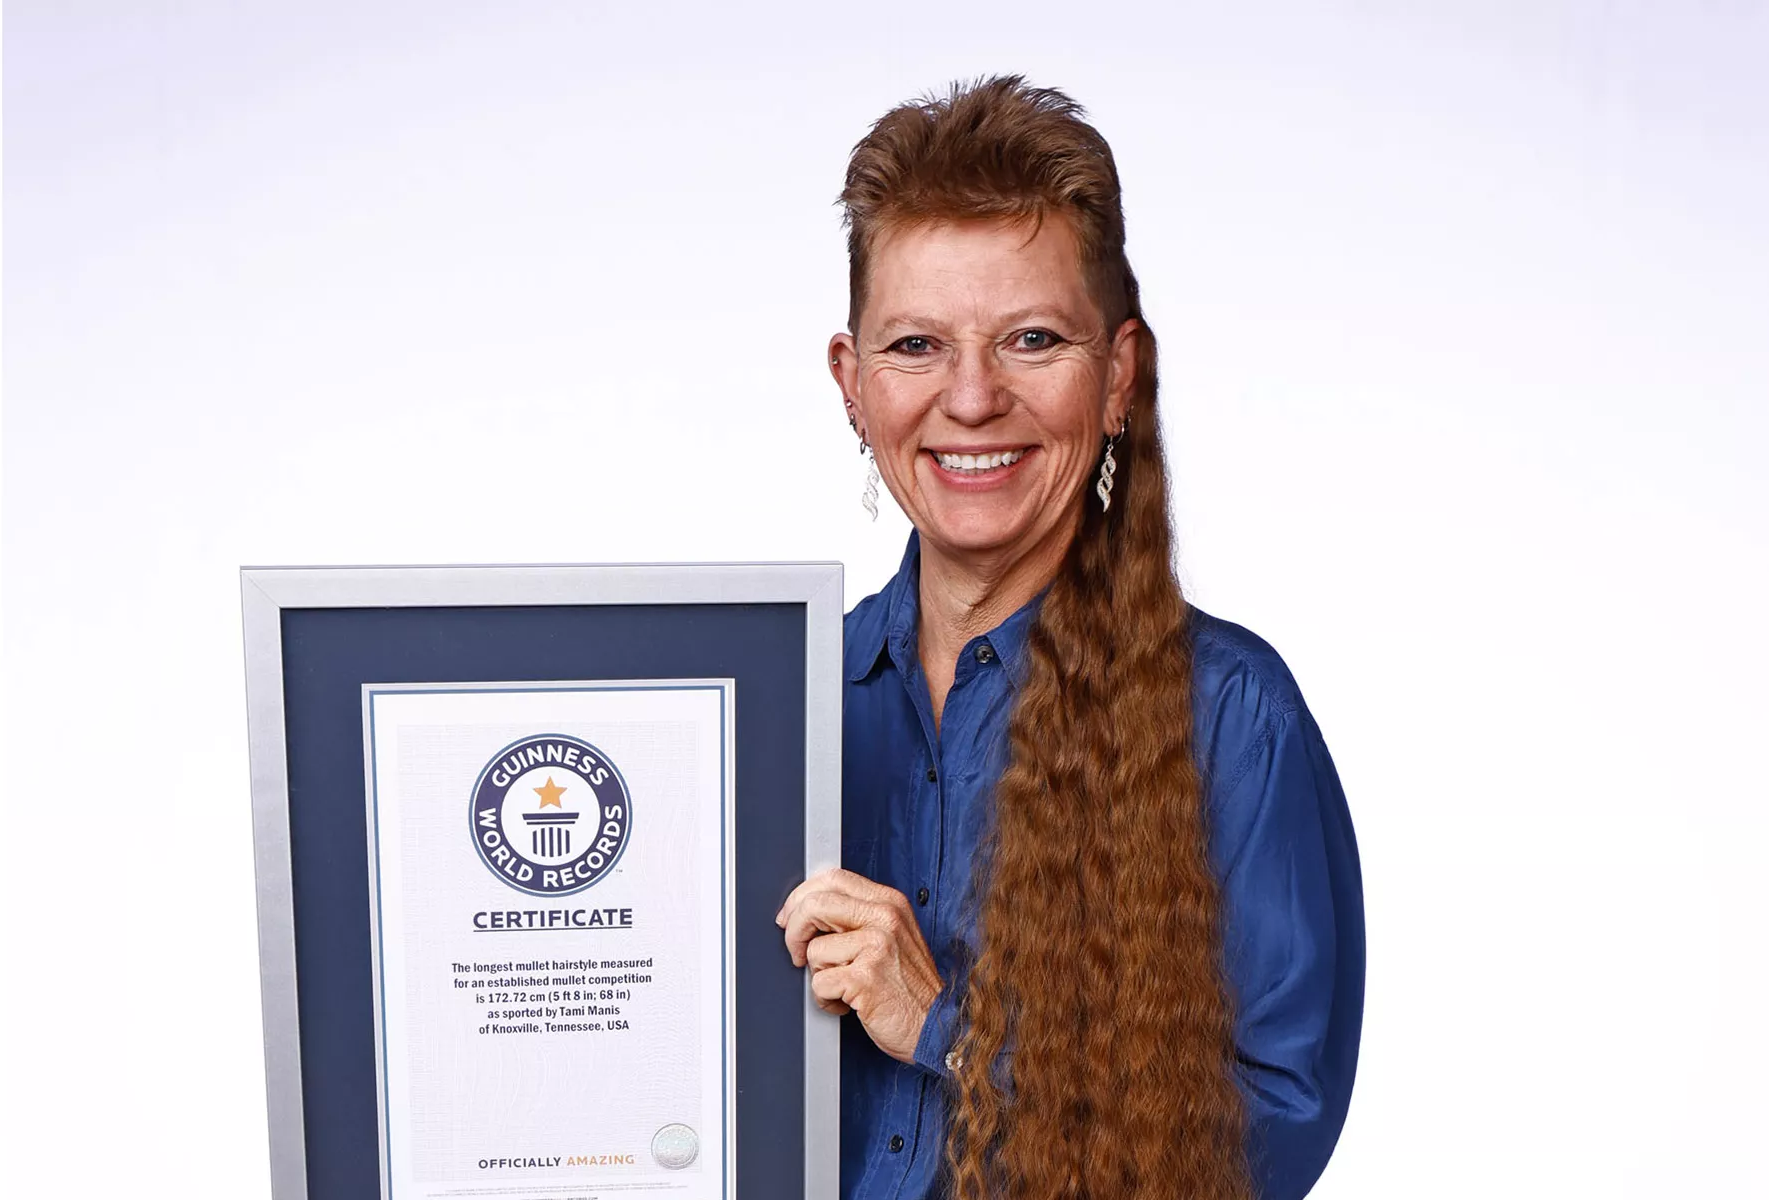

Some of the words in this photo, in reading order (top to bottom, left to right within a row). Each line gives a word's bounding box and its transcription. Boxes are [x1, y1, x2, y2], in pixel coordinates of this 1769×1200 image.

[492, 745, 609, 787] GUINNESS
[479, 808, 533, 882] WORLD
[543, 805, 622, 887] RECORDS
[473, 909, 633, 928] CERTIFICATE
[452, 963, 470, 972] The
[474, 961, 513, 974] longest
[516, 961, 549, 971] mullet
[552, 959, 597, 971] hairstyle
[601, 958, 653, 969] measured
[454, 979, 468, 988] for
[472, 980, 484, 988] an
[488, 977, 549, 987] established
[552, 975, 585, 985] mullet
[589, 973, 652, 986] competition
[476, 994, 485, 1003] is
[489, 993, 526, 1003] 172.72
[530, 994, 545, 1002] cm
[549, 991, 560, 1003] (5
[563, 991, 571, 1000] ft
[574, 991, 580, 1000] 8
[583, 991, 596, 1001] in;
[599, 990, 613, 999] 68
[616, 989, 631, 1000] in)
[488, 1010, 499, 1018] as
[503, 1007, 542, 1020] sported
[546, 1007, 557, 1019] by
[560, 1006, 584, 1016] Tami
[588, 1005, 620, 1015] Manis
[479, 1024, 490, 1034] of
[493, 1023, 542, 1034] Knoxville,
[545, 1022, 604, 1032] Tennessee,
[607, 1020, 629, 1030] USA
[479, 1157, 561, 1169] OFFICIALLY
[567, 1154, 634, 1166] AMAZING
